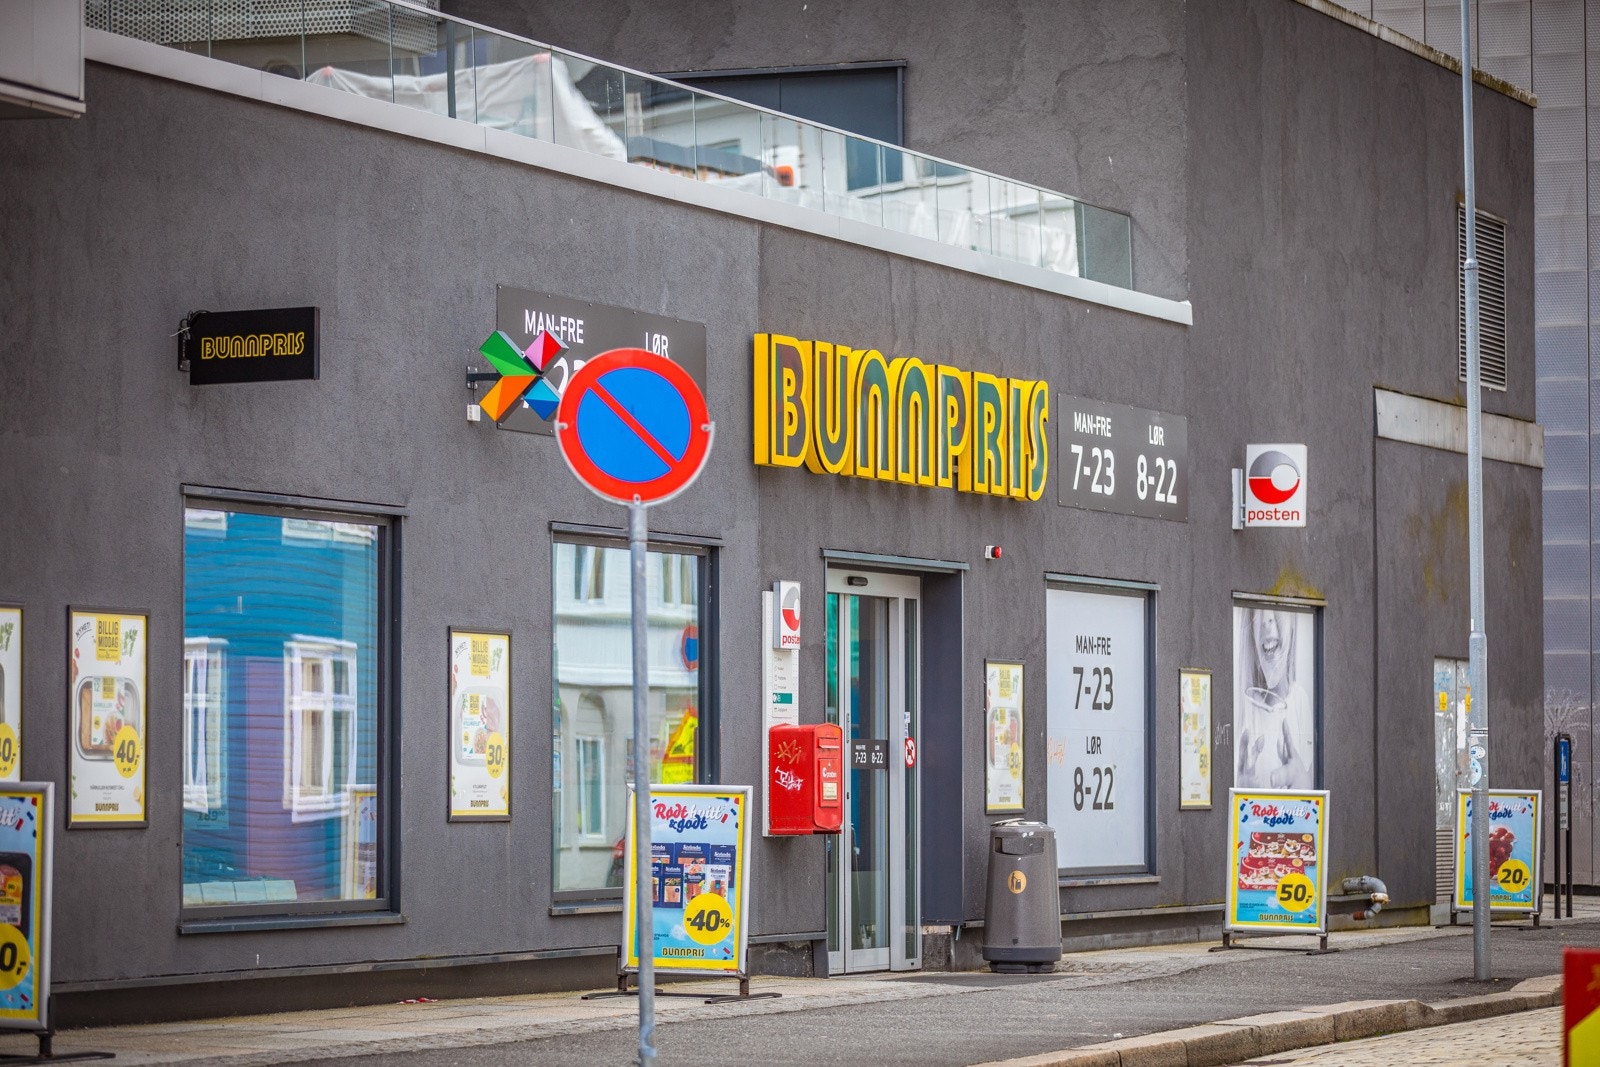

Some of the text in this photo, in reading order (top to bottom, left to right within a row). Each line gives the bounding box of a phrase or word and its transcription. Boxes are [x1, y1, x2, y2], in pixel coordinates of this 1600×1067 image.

[525, 310, 584, 343] MAN-FRE
[201, 331, 305, 359] BUNNPRIS
[645, 332, 669, 358] LØR
[754, 333, 1049, 501] BUNNPRIS
[1074, 412, 1165, 446] MAN-FRE LØR
[1071, 444, 1177, 504] 7-23 8-22
[1247, 507, 1300, 523] posten
[98, 621, 119, 635] BILLIG
[781, 634, 801, 647] poste
[1075, 635, 1112, 656] MAN-FRE
[1072, 666, 1114, 711] 7-23
[1086, 736, 1102, 755] LØR
[854, 752, 884, 764] 7-23 8-22
[1073, 766, 1114, 812] 8-22
[654, 803, 689, 820] Rødt
[1251, 804, 1279, 818] Rødt
[1488, 801, 1500, 811] dt
[1280, 883, 1312, 904] 50,-
[686, 909, 731, 932] -40%
[662, 947, 705, 957] BUNNPRIS
